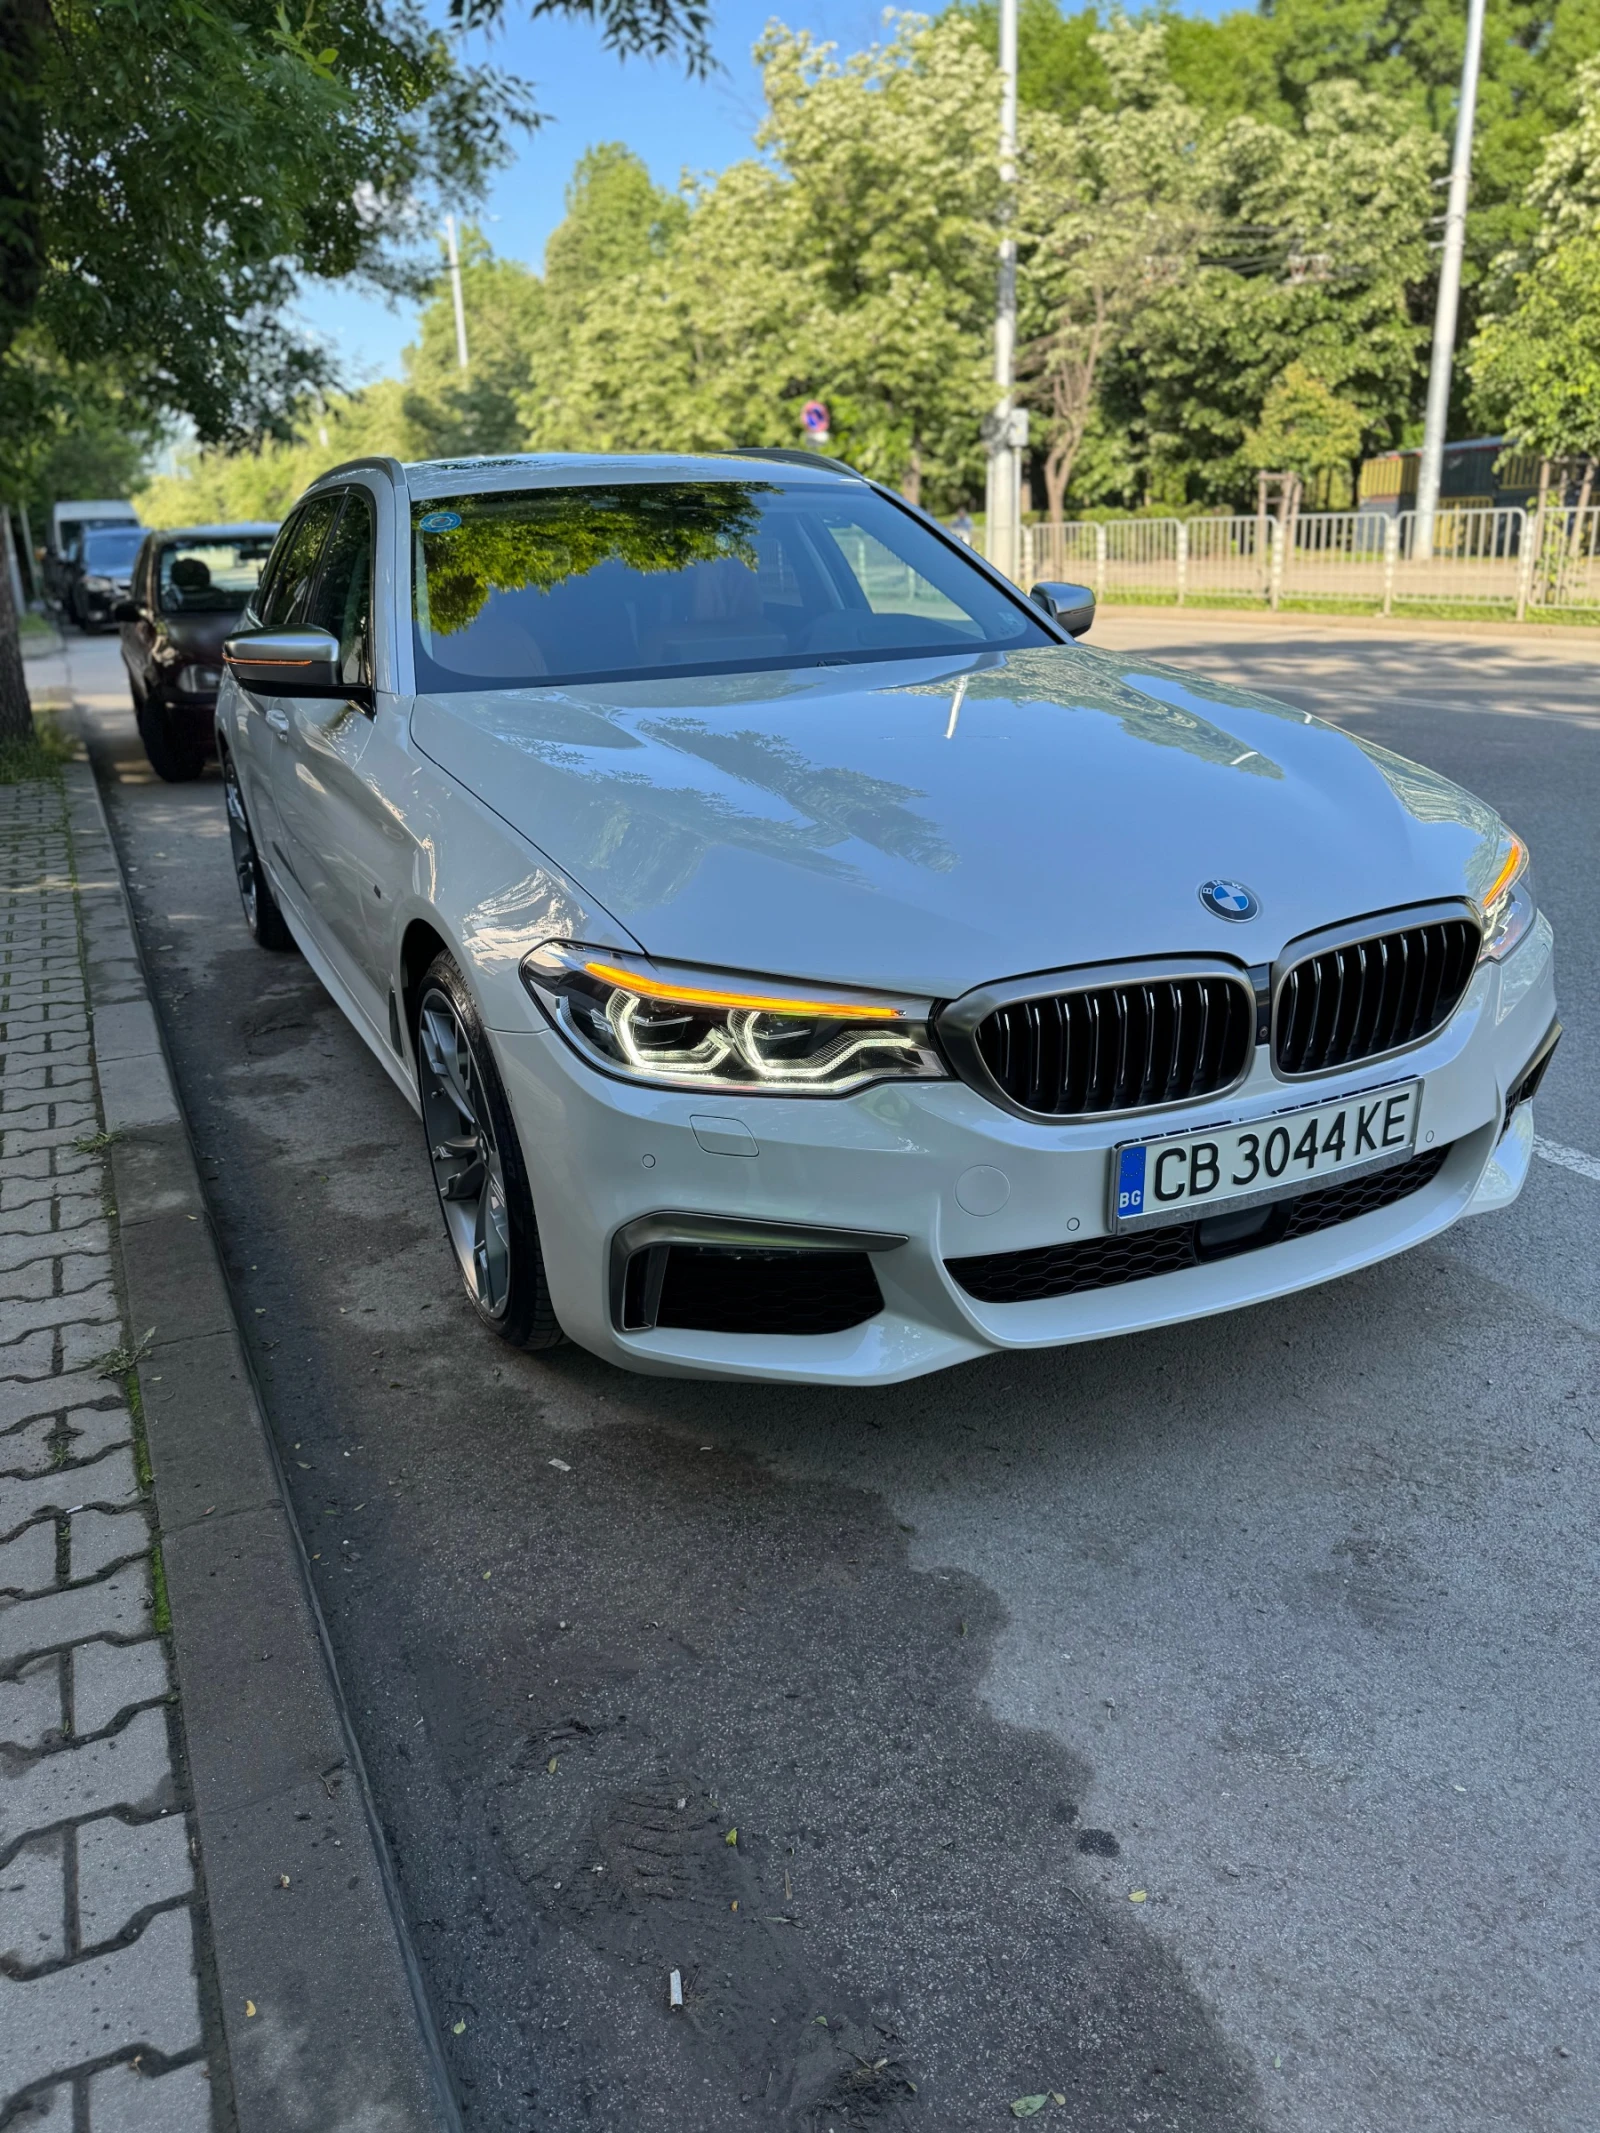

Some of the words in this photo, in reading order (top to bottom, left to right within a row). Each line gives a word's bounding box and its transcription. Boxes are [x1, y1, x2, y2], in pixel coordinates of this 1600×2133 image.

[1203, 880, 1242, 894] BMW
[1155, 1142, 1220, 1201] CB
[1232, 1111, 1346, 1186] 3044
[1355, 1094, 1410, 1155] KE
[1118, 1189, 1142, 1208] BG
